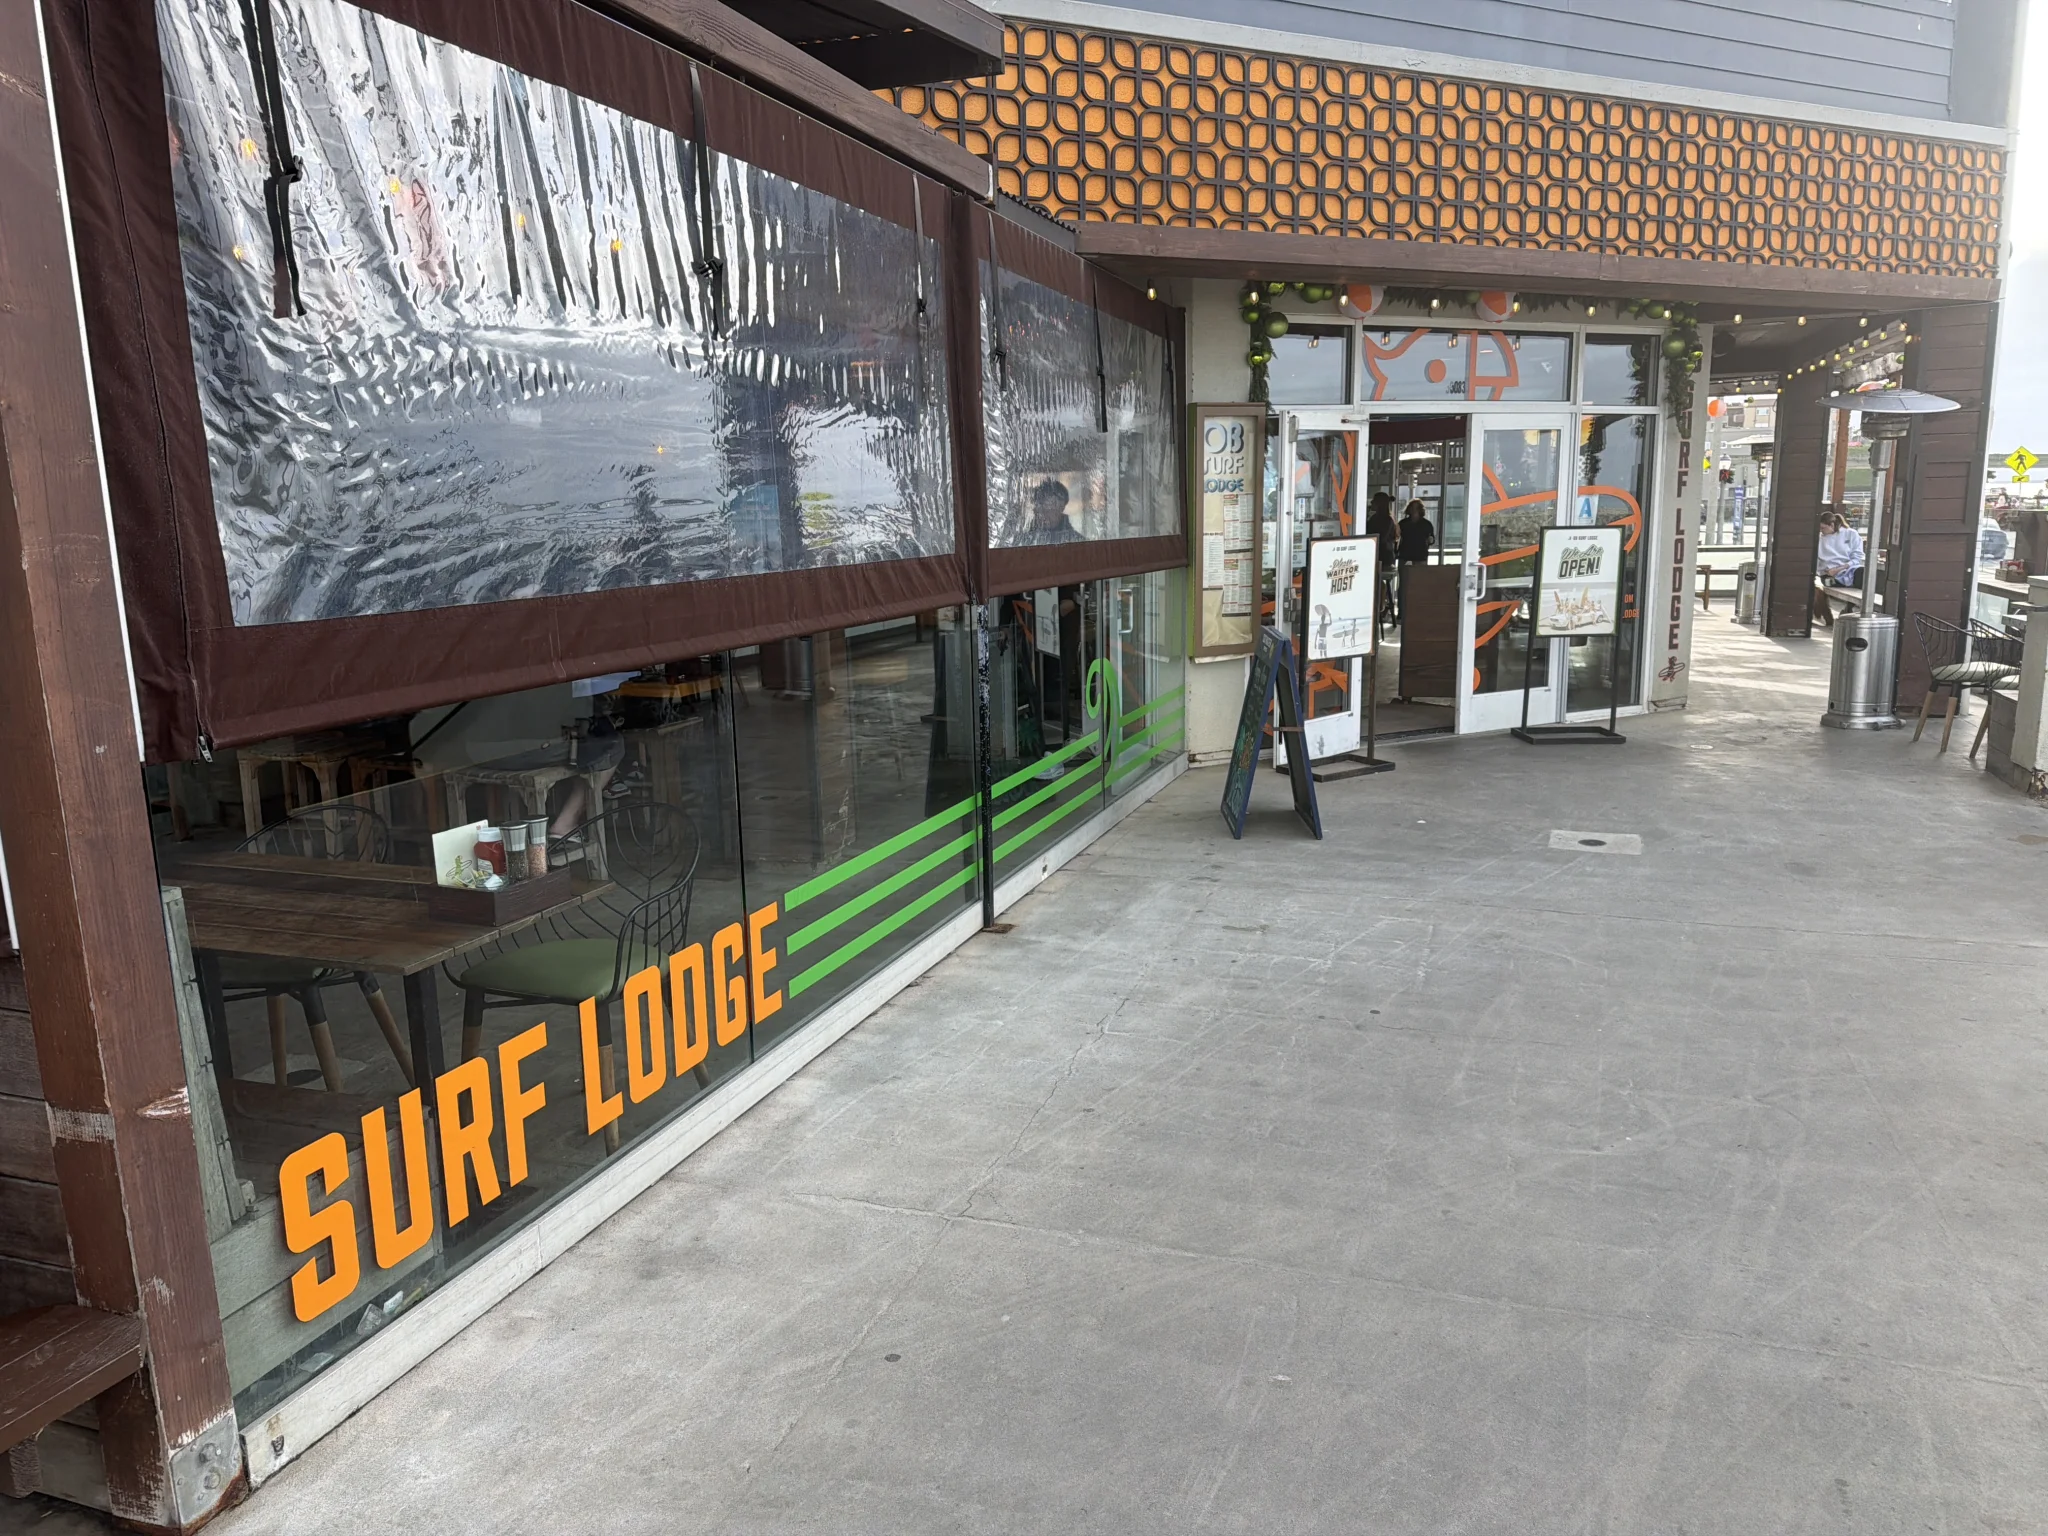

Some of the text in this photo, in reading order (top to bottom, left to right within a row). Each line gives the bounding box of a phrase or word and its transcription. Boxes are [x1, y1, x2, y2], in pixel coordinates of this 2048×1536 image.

[1204, 422, 1244, 454] OB
[1579, 498, 1592, 517] A
[1561, 544, 1604, 560] We Are
[1326, 564, 1359, 579] WAIT FOR
[1559, 556, 1601, 578] OPEN!
[1330, 575, 1355, 595] HOST
[1668, 508, 1685, 650] LODGE
[1623, 609, 1640, 618] ODGE
[279, 902, 782, 1322] SURF LODGE
